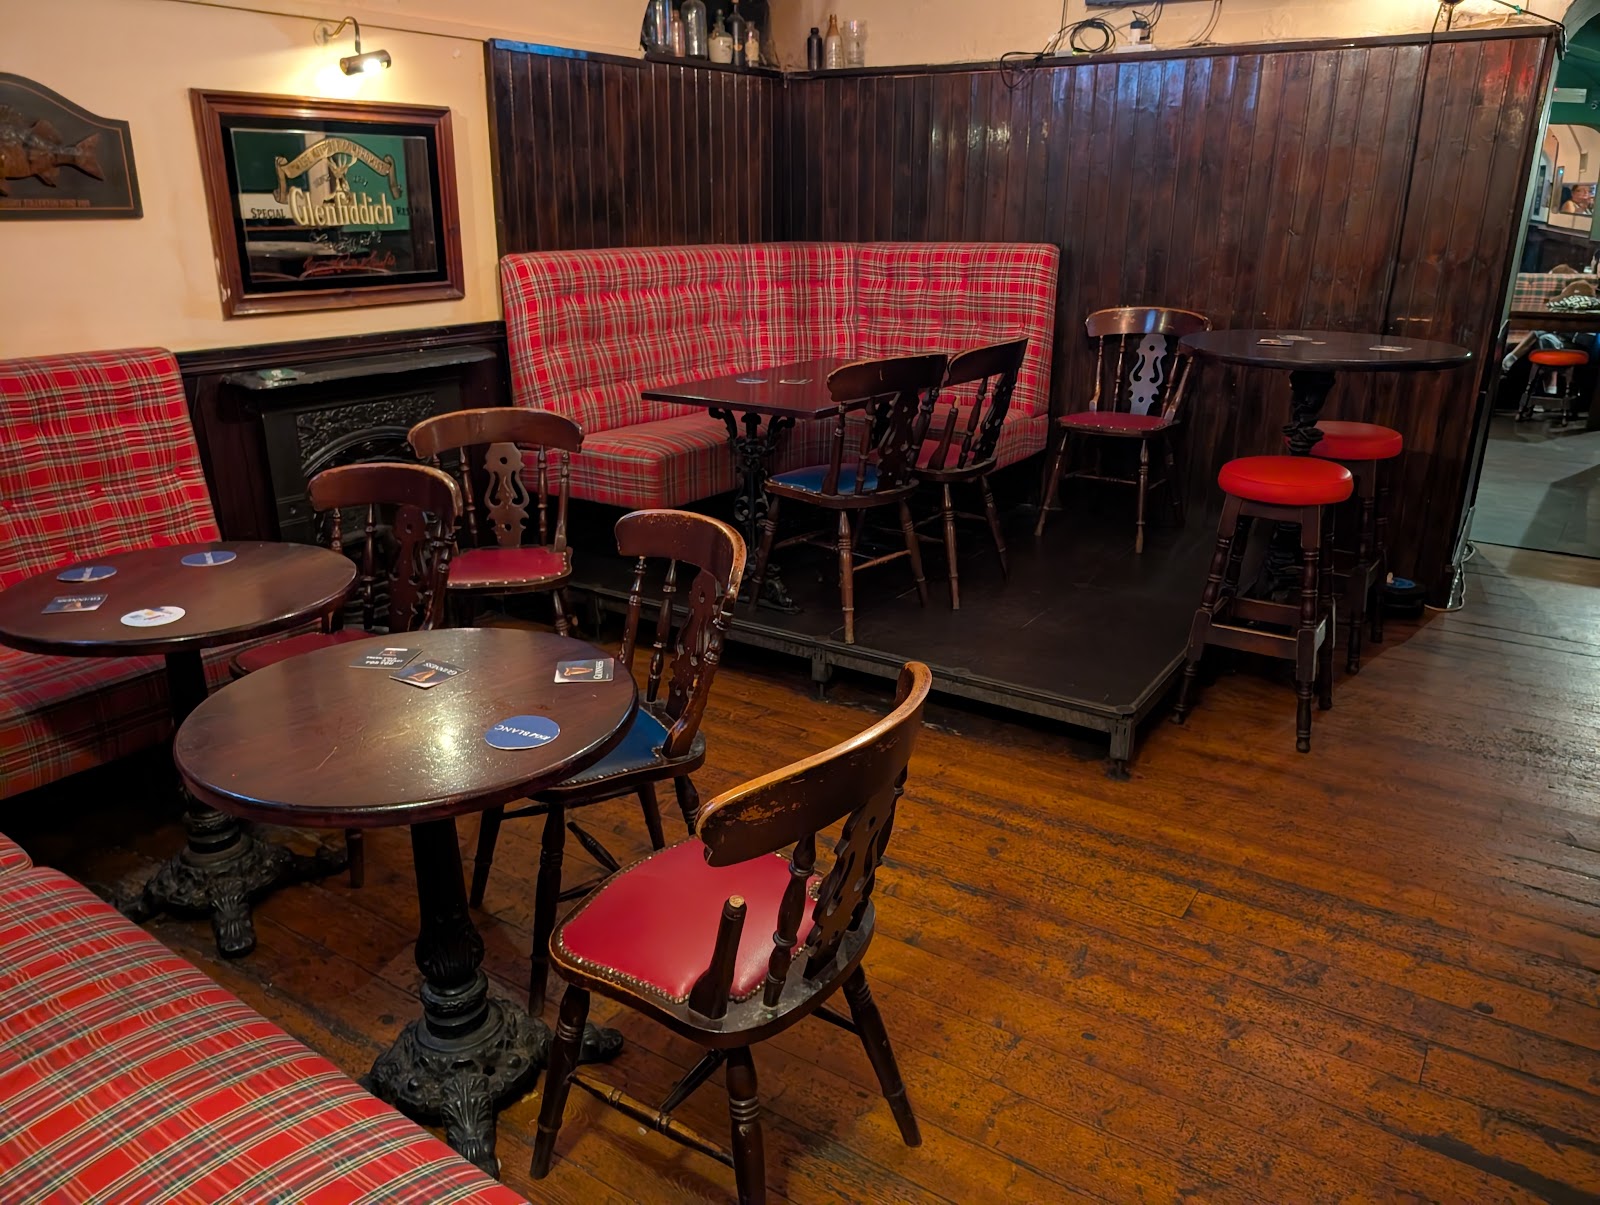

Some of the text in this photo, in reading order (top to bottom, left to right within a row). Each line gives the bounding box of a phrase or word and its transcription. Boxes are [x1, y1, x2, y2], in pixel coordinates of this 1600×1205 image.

[250, 186, 394, 226] SPECIAL Glenfiddich
[494, 724, 531, 737] BLANC
